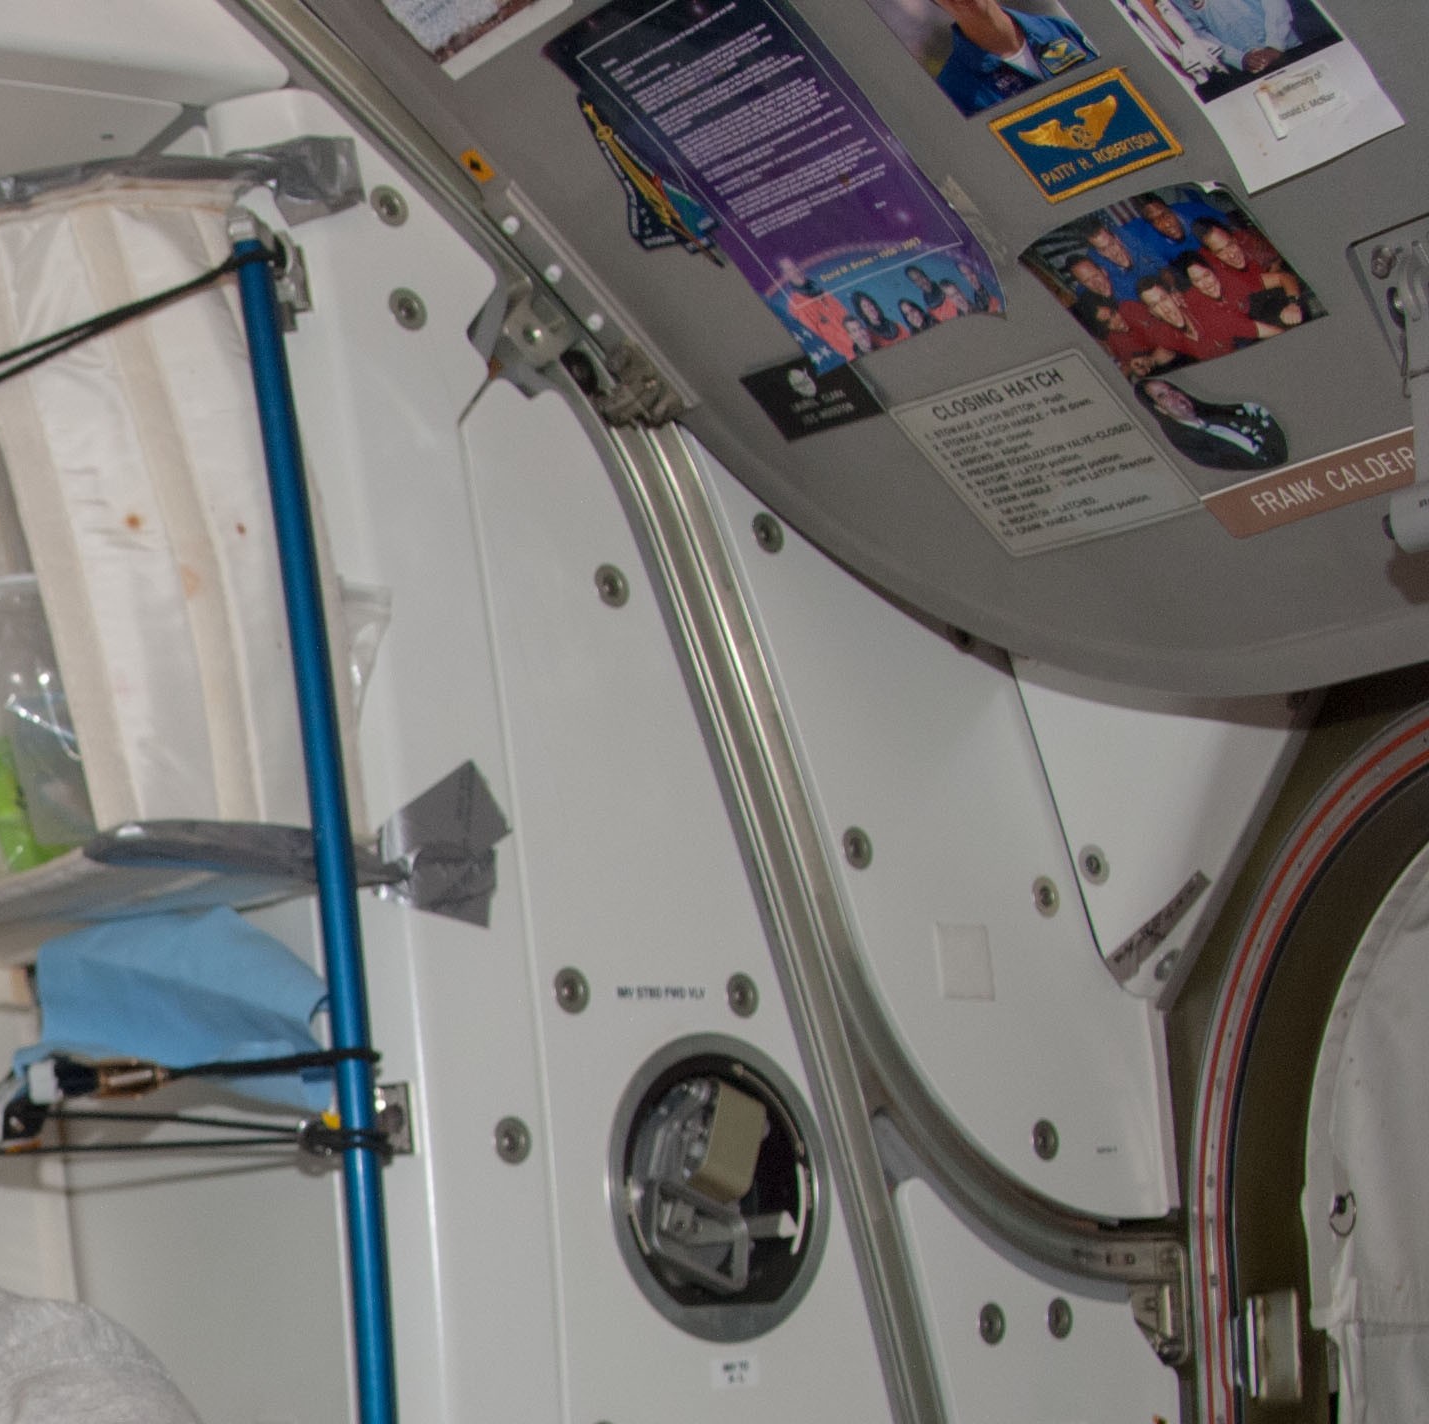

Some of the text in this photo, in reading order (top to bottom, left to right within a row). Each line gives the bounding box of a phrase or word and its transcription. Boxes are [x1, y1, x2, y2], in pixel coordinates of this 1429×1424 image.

[1042, 131, 1161, 187] PATTY H. ROBERTSON
[931, 367, 1065, 422] CLOSING HATCH
[1250, 447, 1416, 516] FRANK CALDEIR
